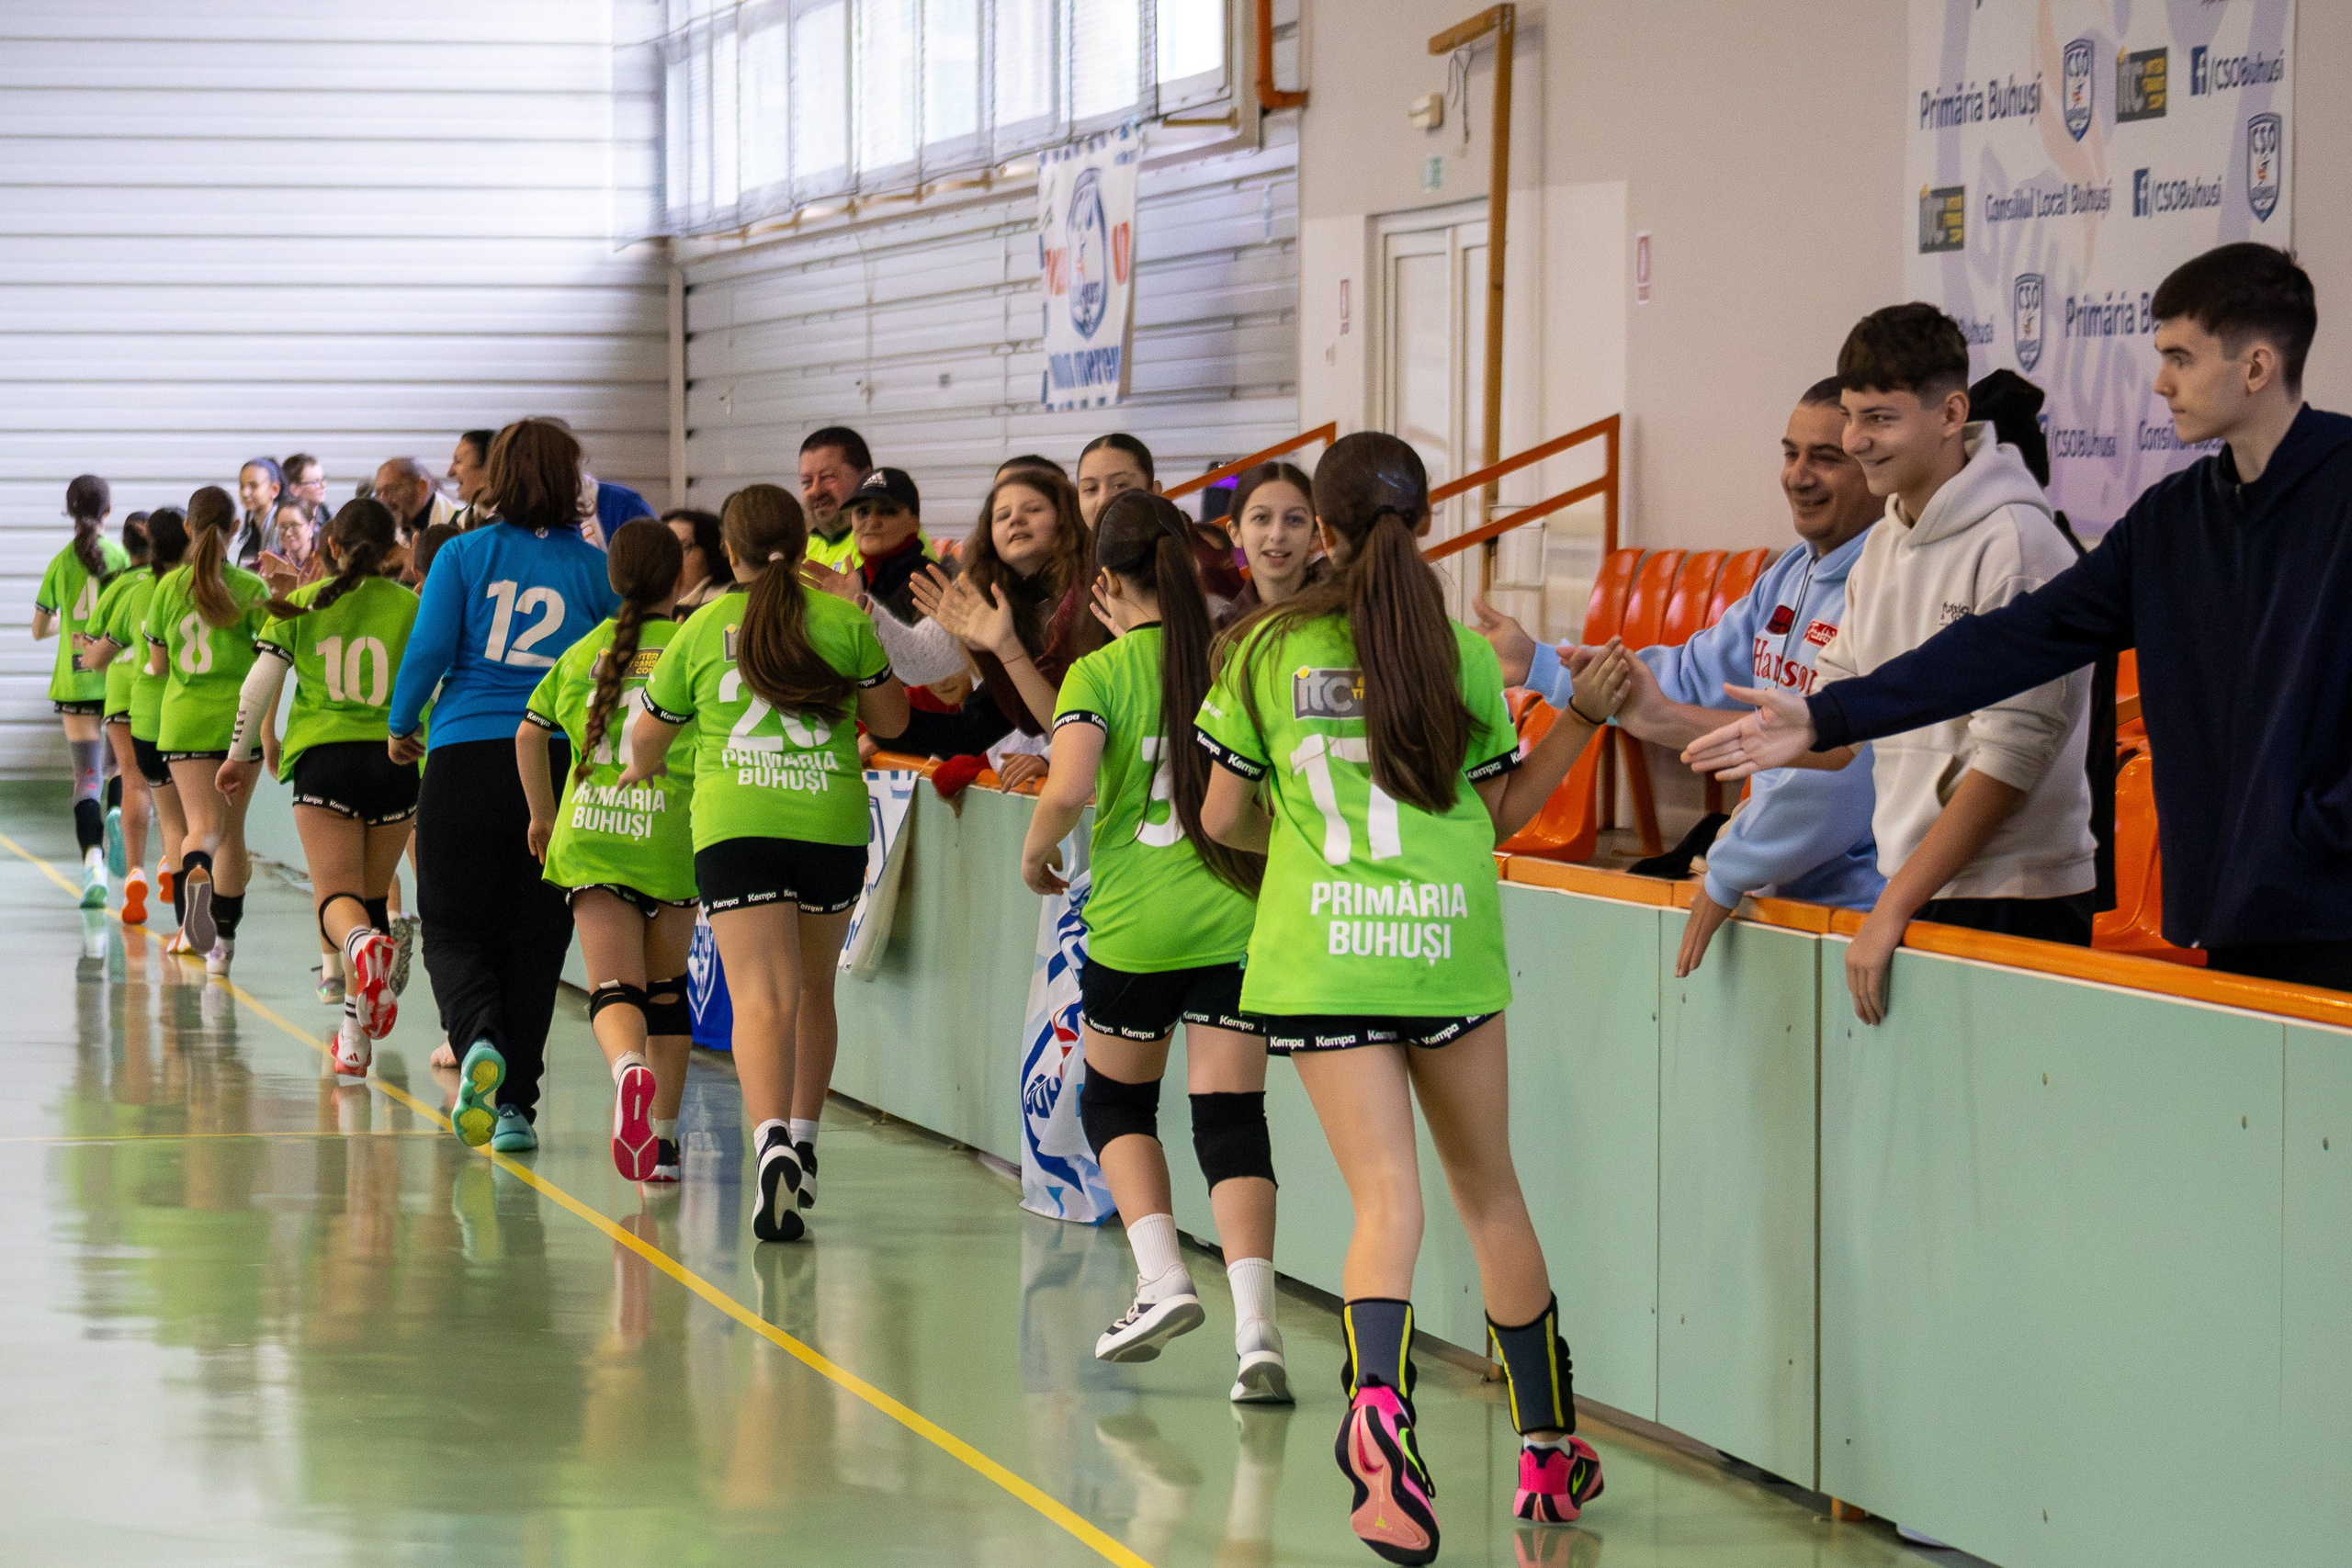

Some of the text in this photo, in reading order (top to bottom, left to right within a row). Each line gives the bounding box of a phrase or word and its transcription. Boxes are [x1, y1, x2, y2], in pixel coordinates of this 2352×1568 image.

[2037, 184, 2067, 219] Local
[483, 579, 566, 669] 12
[179, 611, 213, 674] 8
[316, 636, 390, 706] 10
[738, 766, 829, 796] BUHUȘI
[571, 806, 653, 842] BUHUȘI
[712, 897, 740, 909] Kempa
[747, 891, 776, 903] Kempa
[1310, 878, 1468, 919] PRIMĂRIA
[1328, 919, 1451, 968] BUHUȘI
[1121, 1026, 1156, 1041] Kempa
[1182, 1010, 1255, 1032] Kempa Kempa
[1270, 1035, 1306, 1050] Kempa
[1315, 1034, 1357, 1048] Kempa
